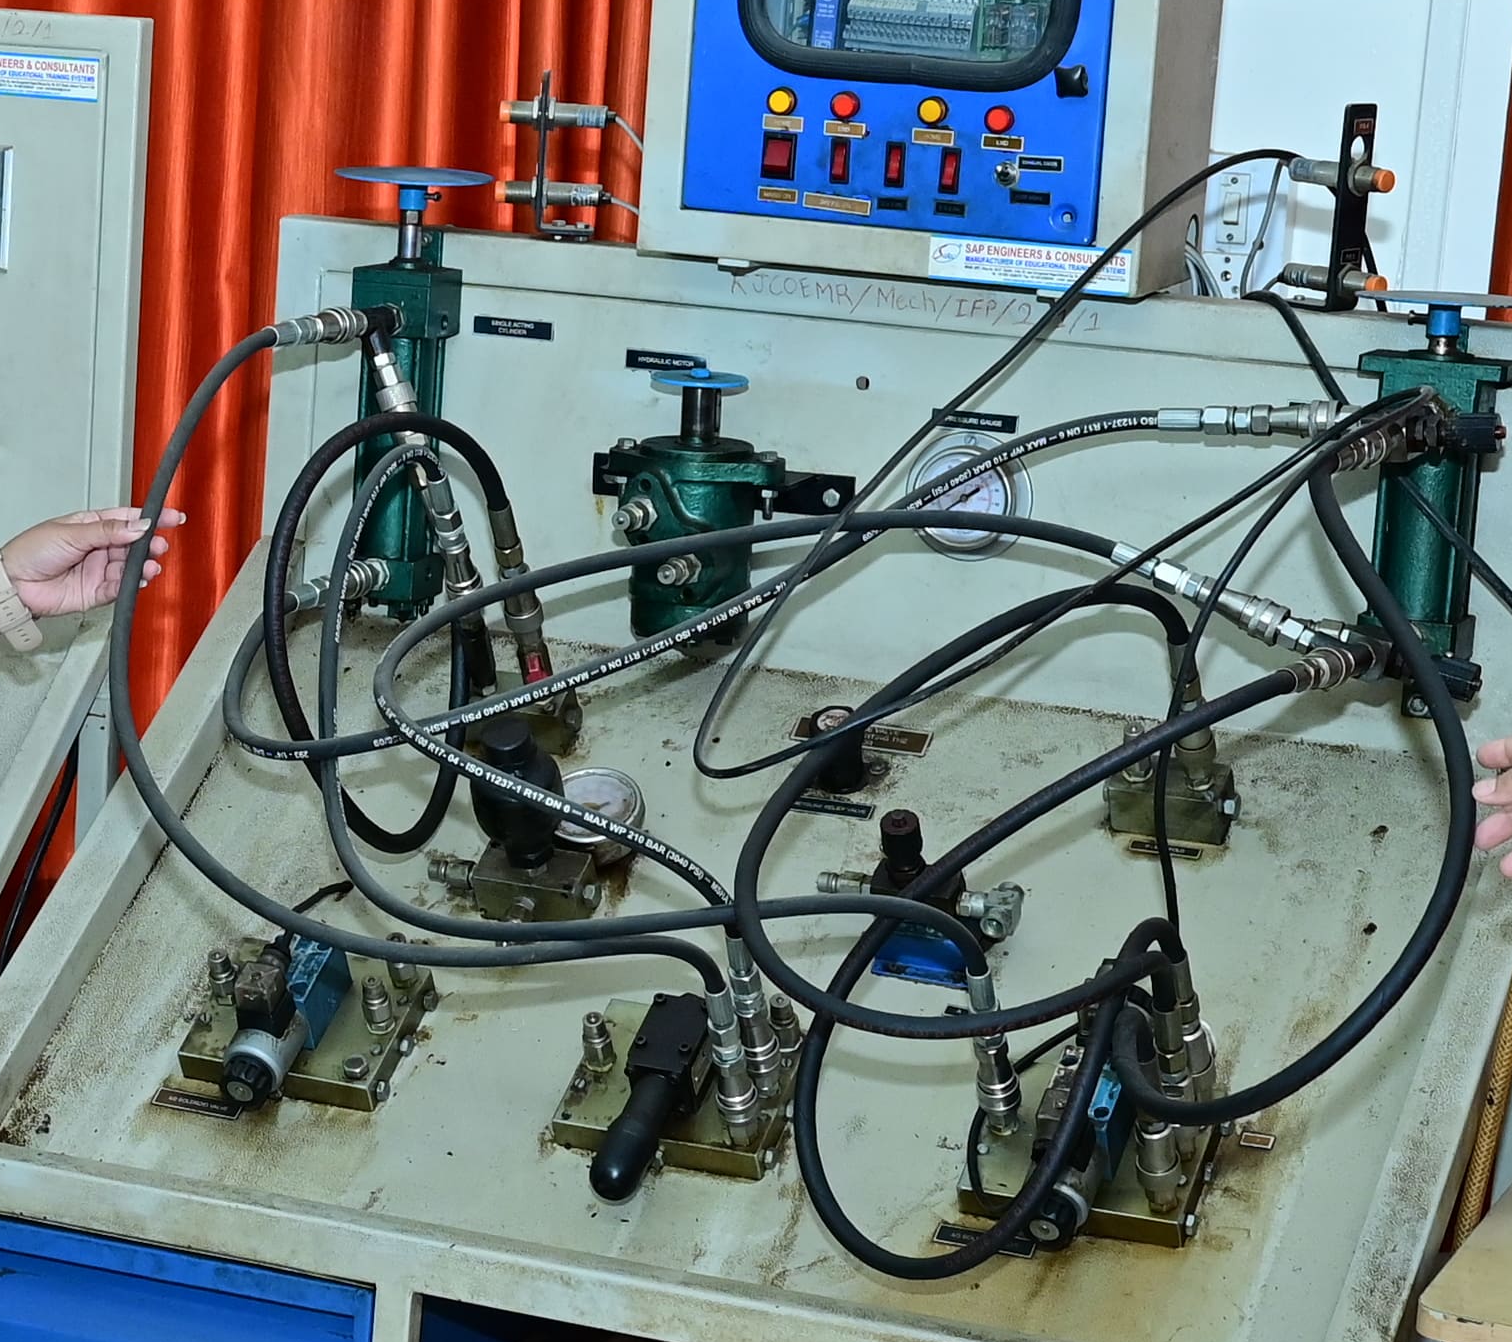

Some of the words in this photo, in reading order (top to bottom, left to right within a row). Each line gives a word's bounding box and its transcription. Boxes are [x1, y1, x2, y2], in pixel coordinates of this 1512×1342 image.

[27, 60, 32, 69] &
[35, 61, 96, 75] CONSULTANTS
[8, 70, 44, 79] EDUCATIONAL
[46, 73, 70, 81] TRAINING
[965, 243, 986, 255] SAP
[987, 245, 1044, 259] ENGINEERS
[1045, 250, 1052, 259] &
[1055, 251, 1126, 267] CONSULNTS
[965, 256, 1014, 265] MANUFACTURER
[1024, 260, 1066, 271] EDUCATIONAL
[498, 328, 528, 337] CYLINDER
[515, 322, 536, 331] ACTING
[638, 356, 672, 365] HYDRAULIC
[673, 359, 694, 367] MOTOR
[980, 418, 1004, 427] GAUGE
[1082, 422, 1102, 435] R17
[1103, 417, 1138, 431] 11237-1
[1066, 425, 1082, 437] DN
[1010, 444, 1026, 459] WP
[1026, 436, 1048, 453] MAX
[993, 451, 1010, 465] 210
[972, 459, 992, 475] BAR
[746, 596, 762, 609] SAE
[729, 604, 744, 619] 100
[696, 621, 708, 633] 04
[675, 628, 692, 643] ISO
[643, 635, 674, 657] 11237-1
[608, 658, 622, 671] DN
[624, 650, 642, 665] R17
[568, 671, 590, 687] MAX
[533, 686, 550, 701] 210
[551, 680, 568, 695] WP
[483, 700, 510, 717] (3040
[511, 693, 532, 709] BAR
[462, 709, 482, 725] PSI)
[399, 722, 414, 739] SAE
[414, 733, 428, 747] 100
[447, 754, 460, 767] 04
[465, 762, 484, 777] ISO
[485, 771, 522, 795] 11237-1
[523, 786, 544, 803] R17
[545, 796, 562, 811] DN
[584, 811, 606, 829] MAX
[608, 823, 628, 837] WP
[628, 831, 644, 845] 210
[645, 837, 666, 855] BAR
[666, 848, 688, 867] (3040
[688, 862, 704, 881] PSI)
